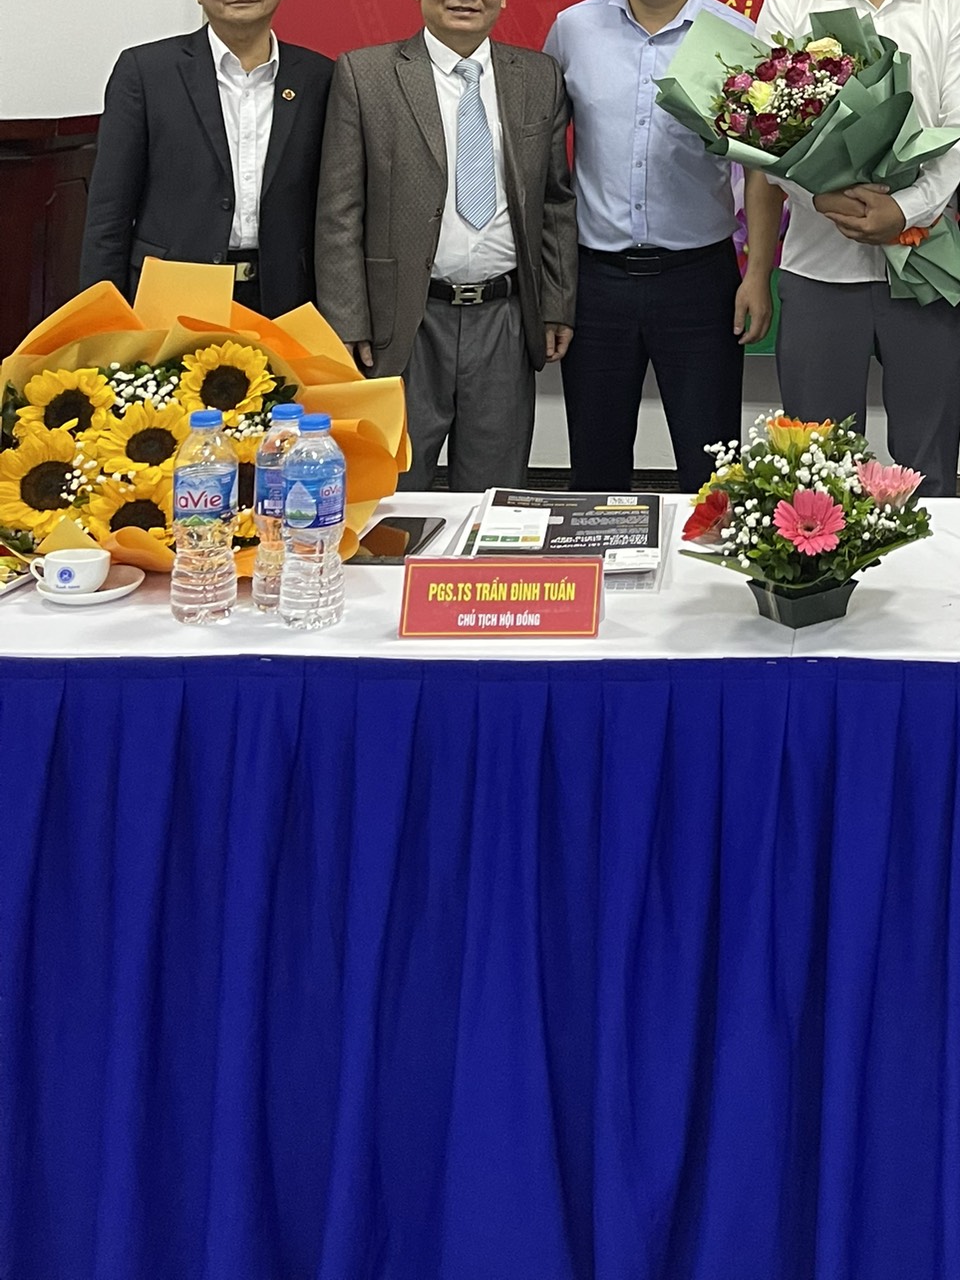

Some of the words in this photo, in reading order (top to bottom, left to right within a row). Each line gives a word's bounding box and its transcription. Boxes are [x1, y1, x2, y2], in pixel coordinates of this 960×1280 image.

[428, 582, 473, 602] PGS.TS
[509, 578, 541, 602] ĐÌNH
[543, 576, 576, 601] TUẤN
[457, 608, 476, 627] CHỦ
[477, 613, 498, 629] TỊCH
[498, 610, 515, 629] HỘI
